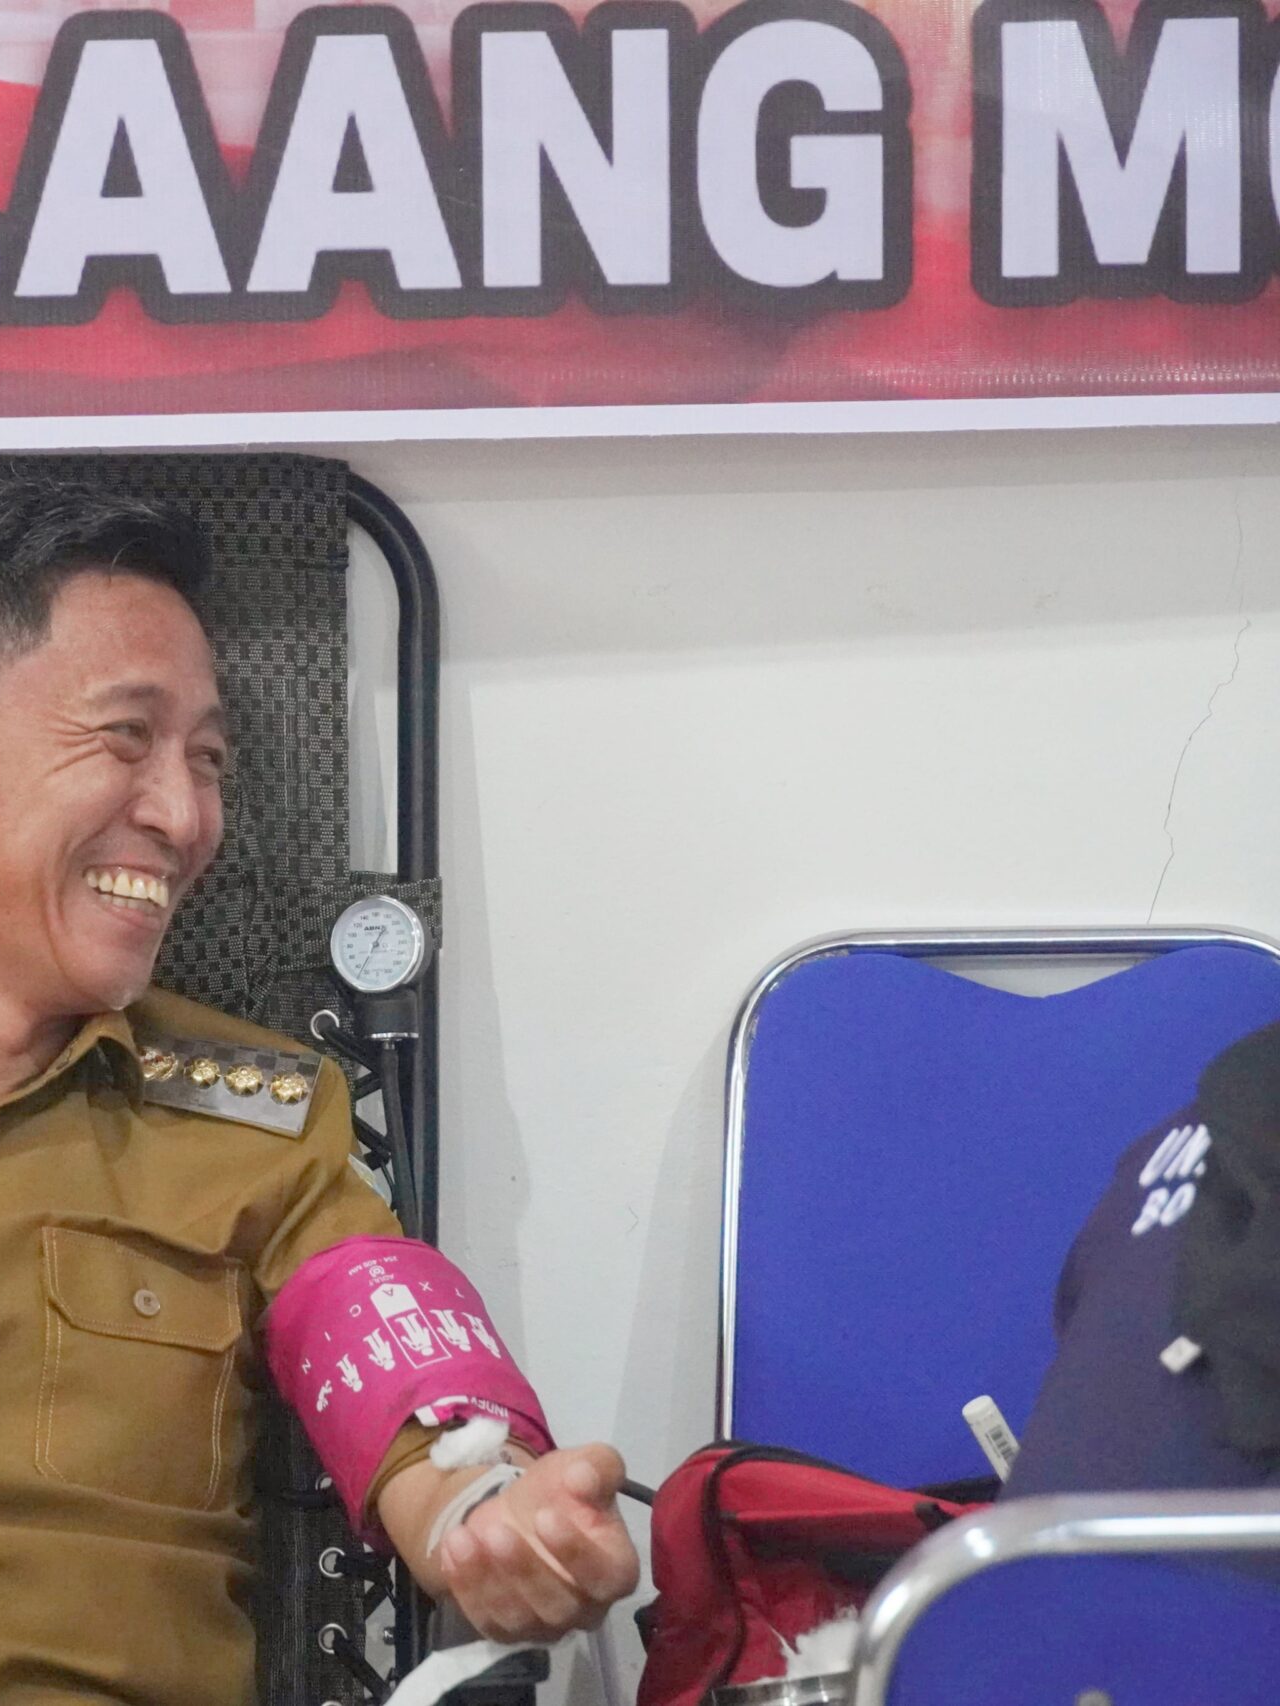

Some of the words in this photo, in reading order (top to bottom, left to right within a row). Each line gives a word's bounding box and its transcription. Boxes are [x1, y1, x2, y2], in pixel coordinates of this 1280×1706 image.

[999, 17, 1280, 279] M
[381, 1287, 394, 1297] A
[348, 1304, 362, 1318] C
